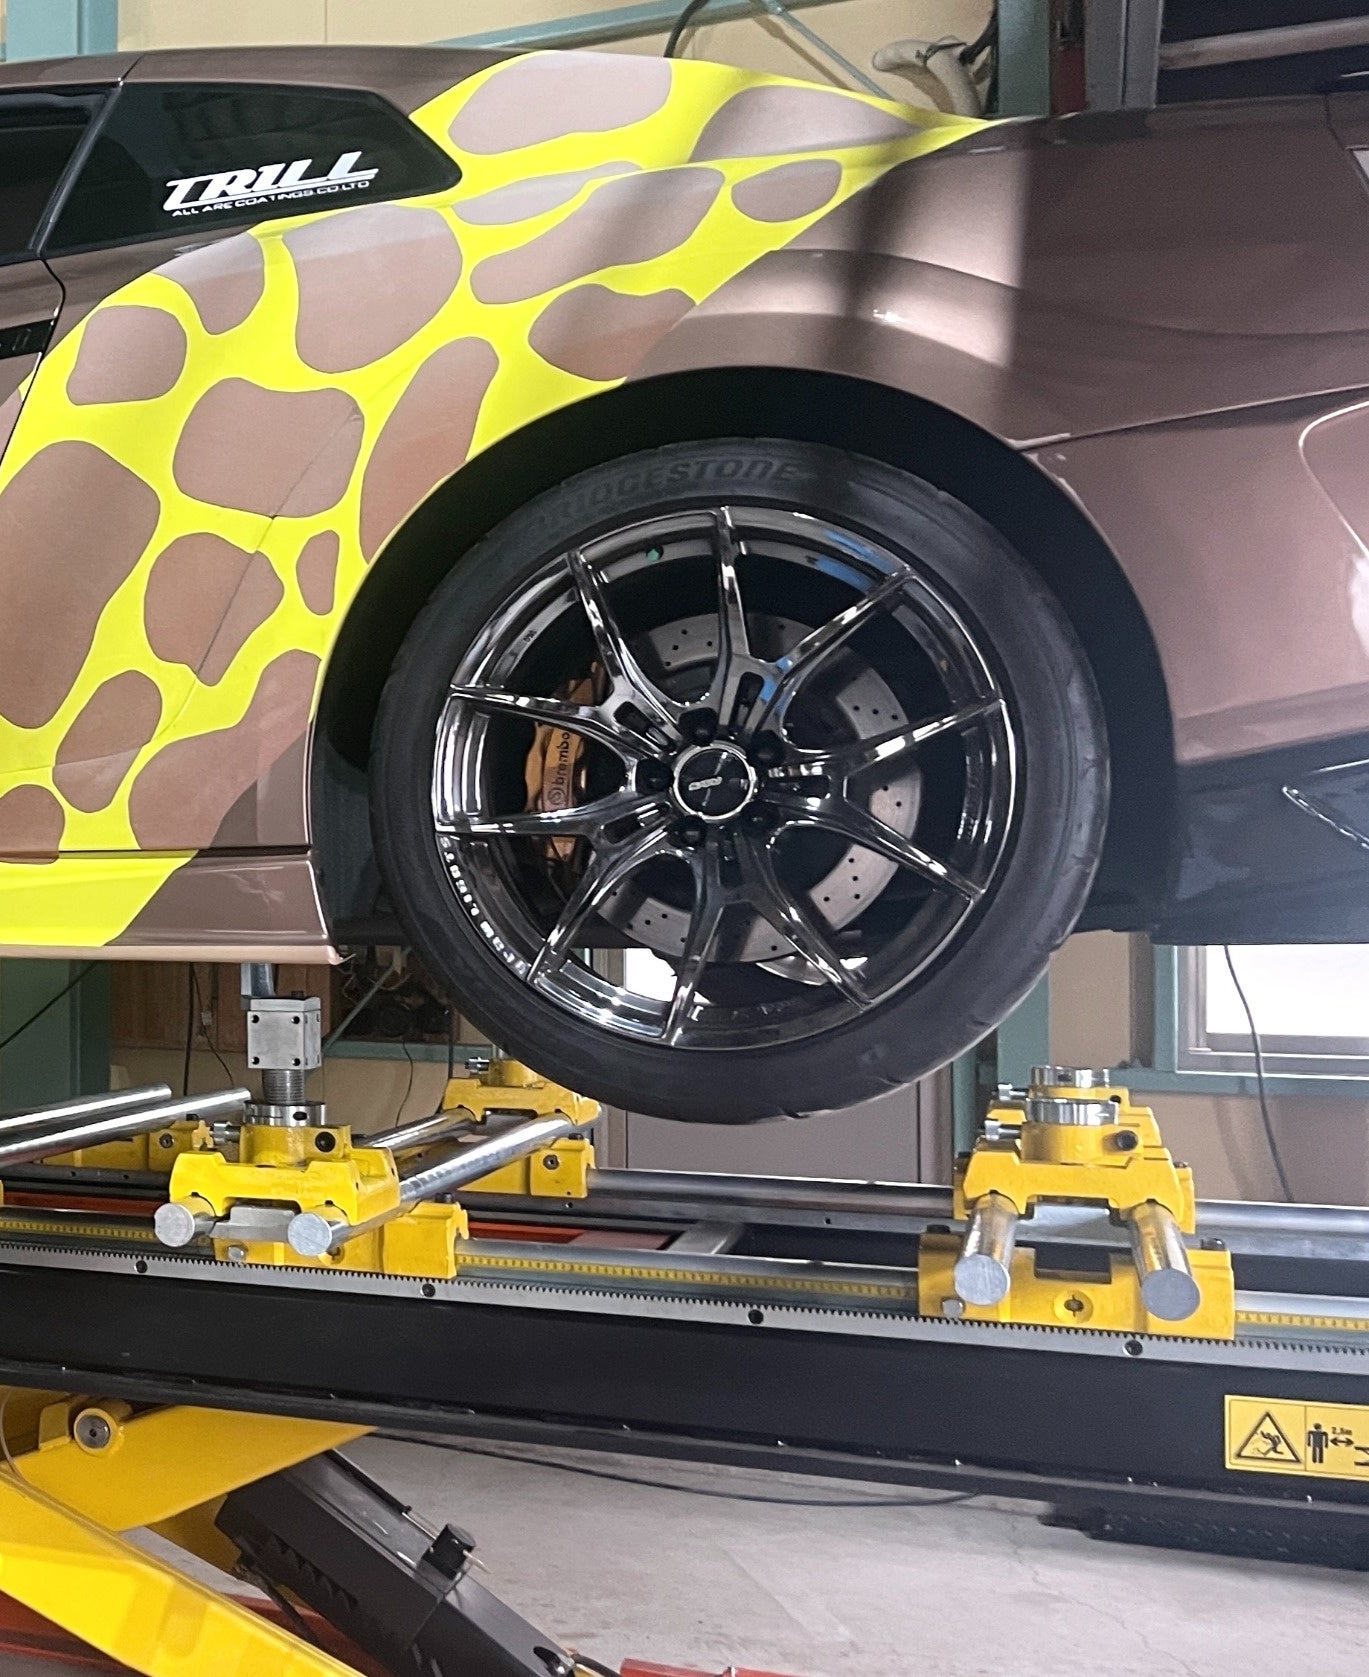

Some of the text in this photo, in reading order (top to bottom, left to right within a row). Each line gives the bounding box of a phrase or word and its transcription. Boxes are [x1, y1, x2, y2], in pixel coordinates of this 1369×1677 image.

[163, 151, 379, 211] TRILL
[171, 208, 199, 217] ALL
[234, 189, 314, 209] COATINGS
[552, 731, 571, 786] brembo
